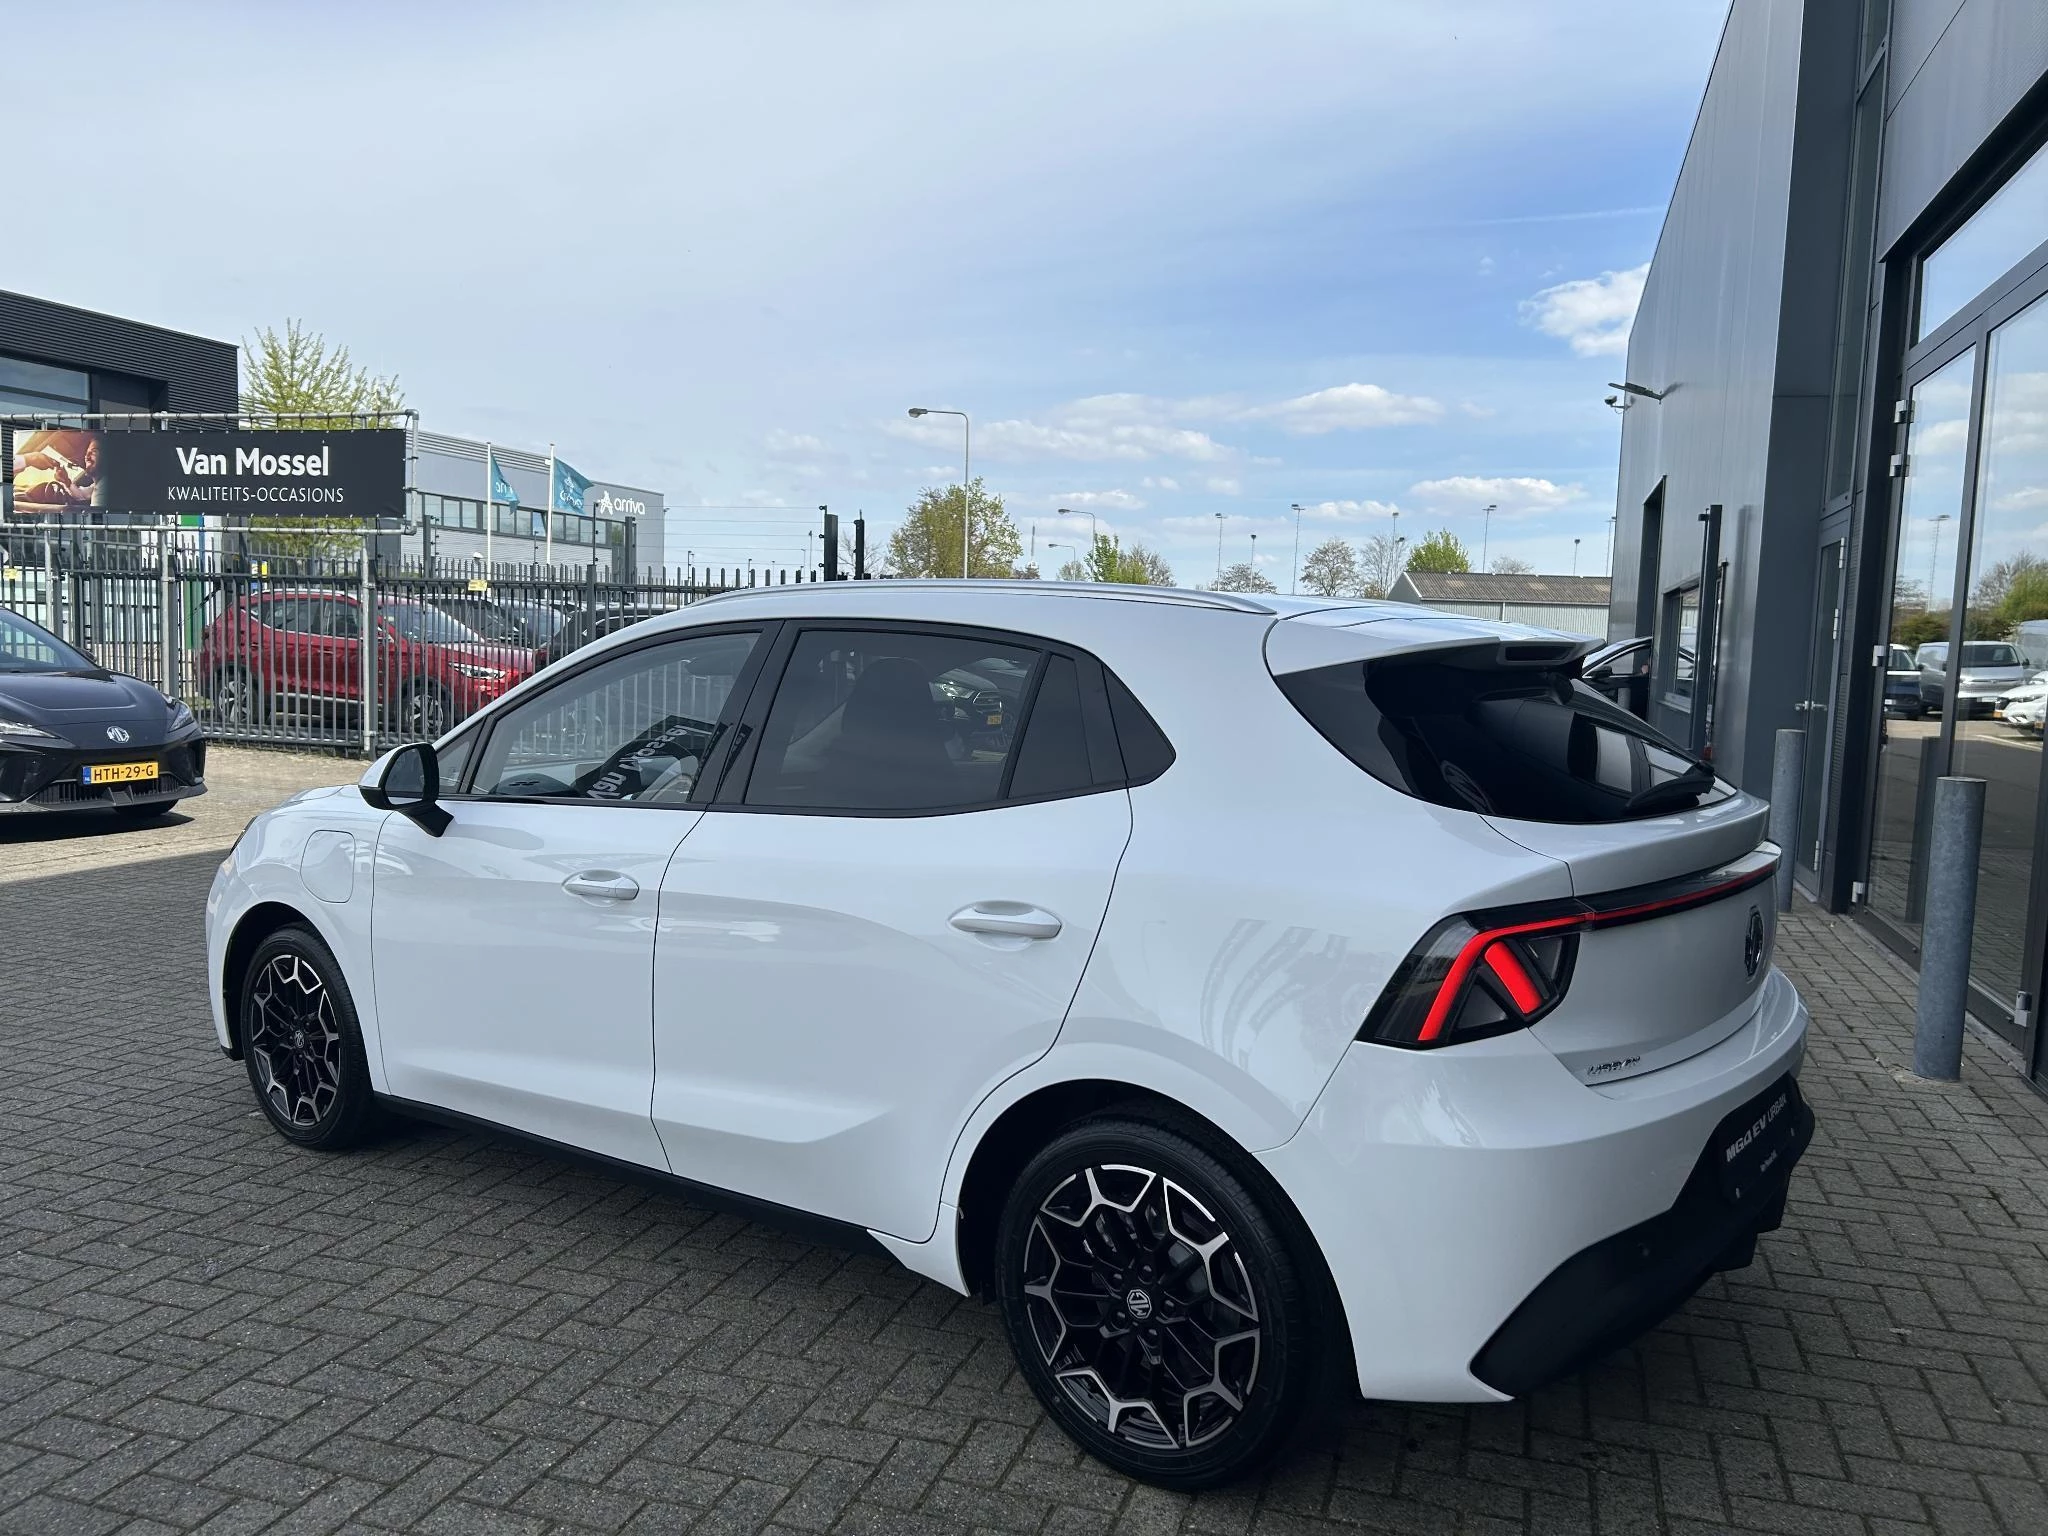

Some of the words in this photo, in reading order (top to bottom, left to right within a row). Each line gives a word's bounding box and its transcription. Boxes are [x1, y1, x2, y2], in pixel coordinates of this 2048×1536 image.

[175, 447, 227, 475] Van
[235, 445, 329, 476] Mossel
[167, 486, 344, 503] KWALITEITS-OCCASIONS
[613, 497, 646, 515] arriva
[106, 725, 130, 744] MG
[93, 765, 154, 781] HTH-29-G
[1752, 1114, 1767, 1138] EV
[1126, 1288, 1153, 1319] MG
